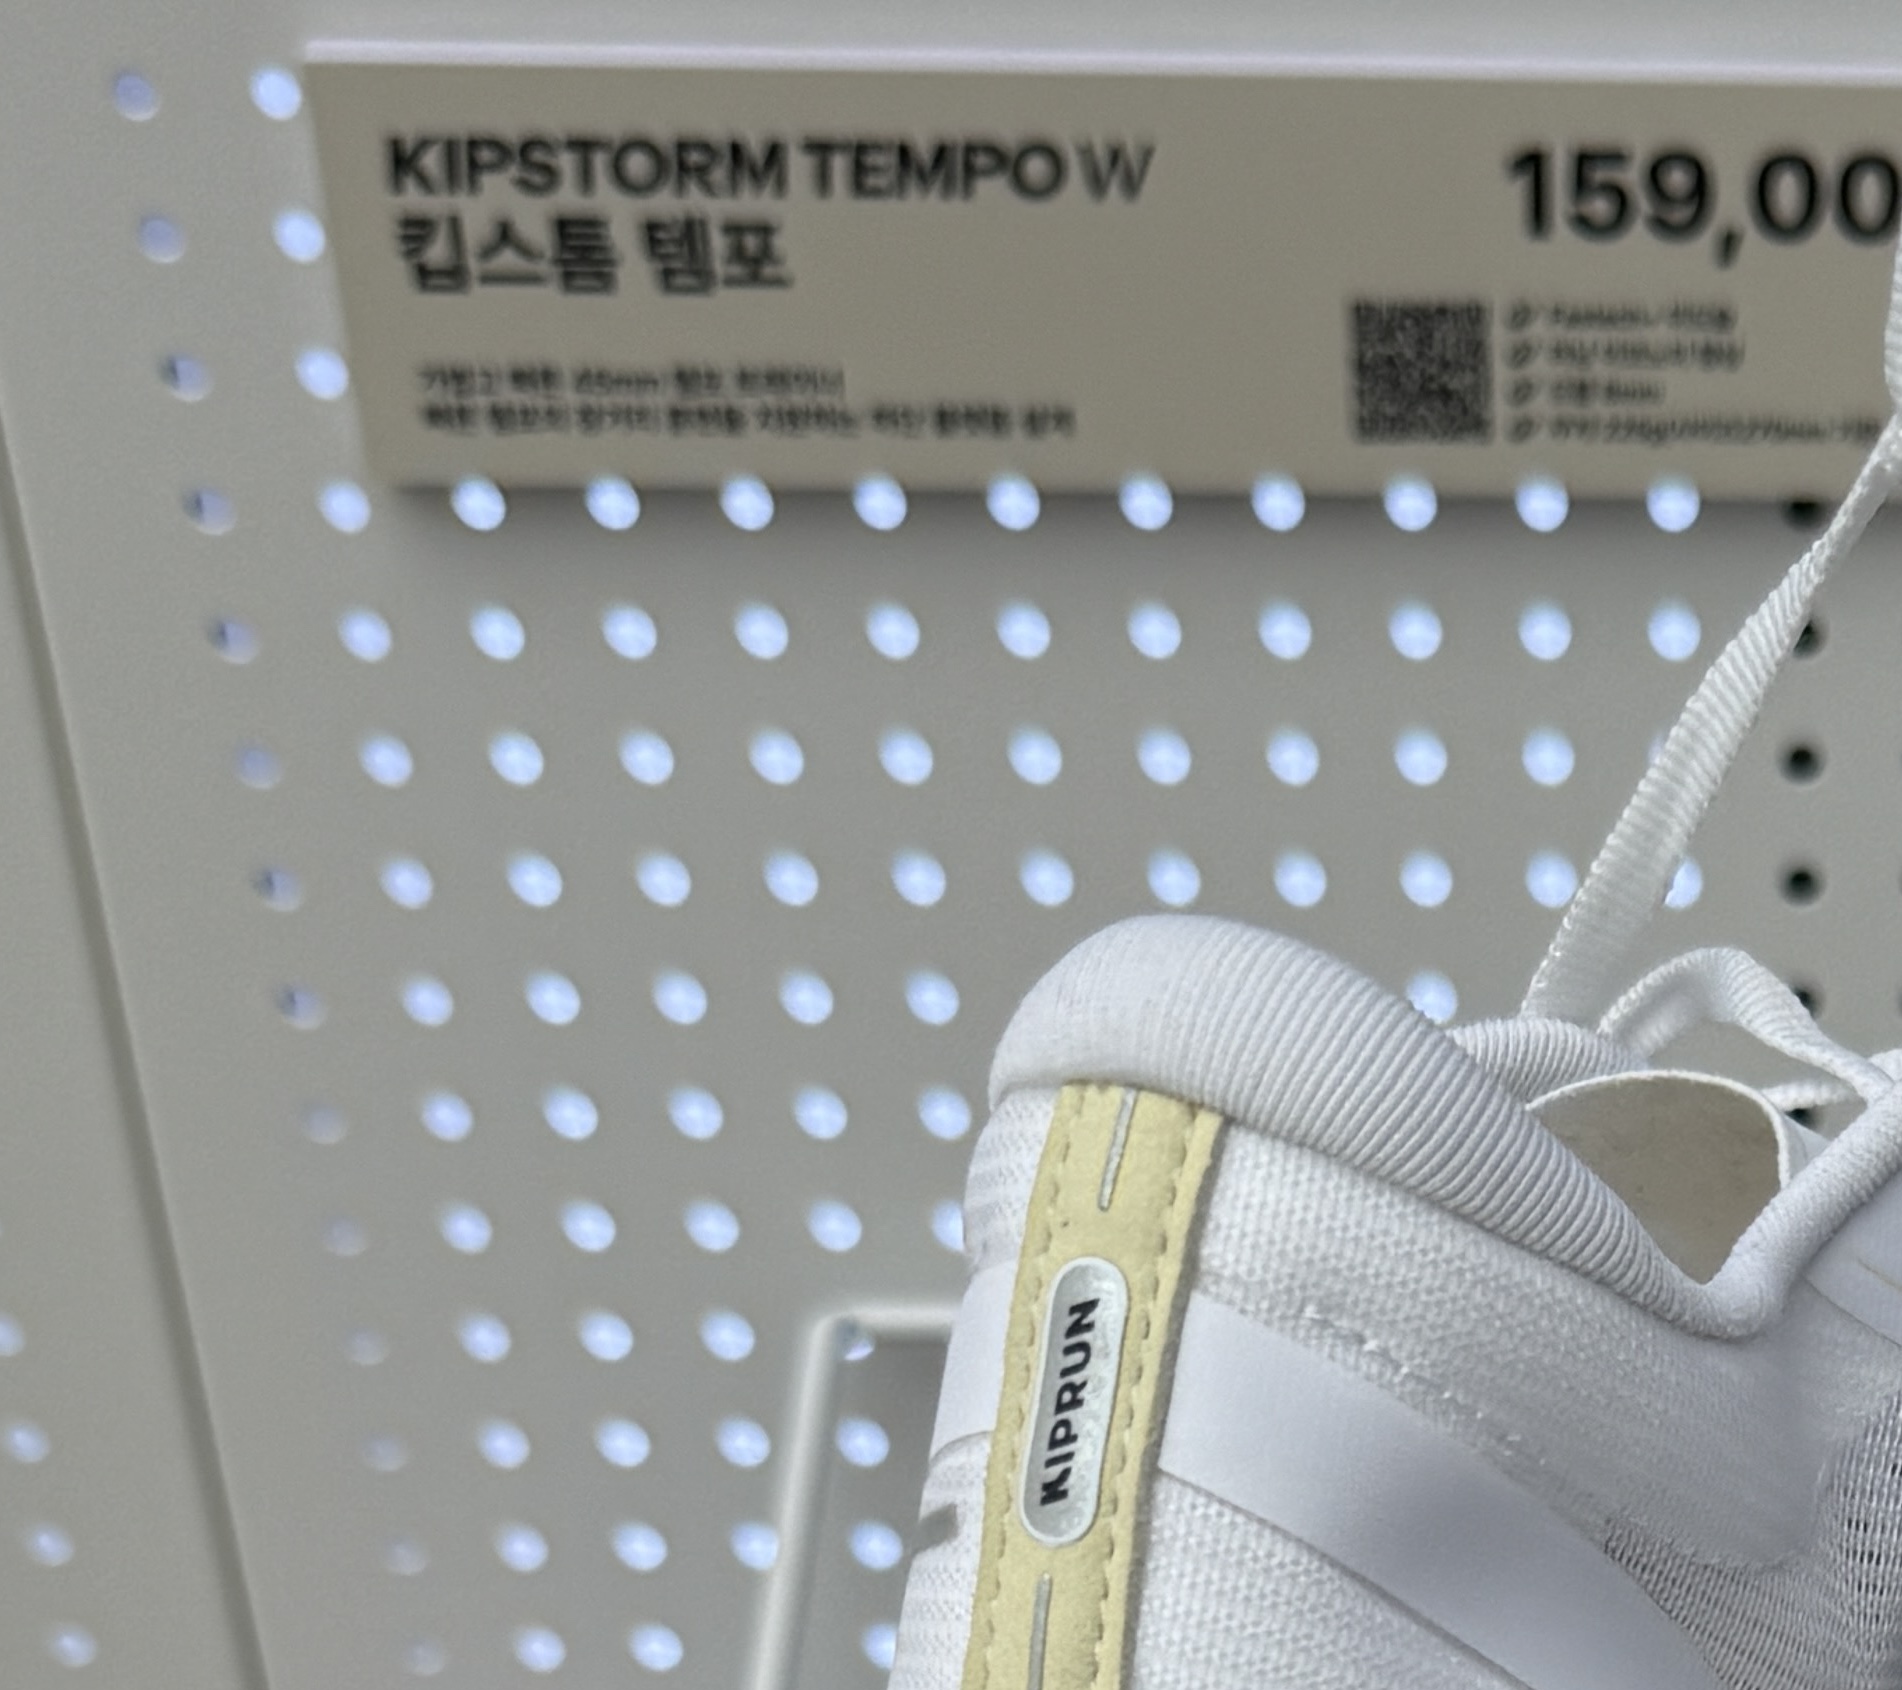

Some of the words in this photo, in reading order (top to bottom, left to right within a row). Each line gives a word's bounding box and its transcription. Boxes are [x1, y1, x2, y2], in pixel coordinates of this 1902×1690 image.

[388, 135, 789, 197] KIPSTORM
[801, 138, 1066, 202] TEMPO
[1074, 142, 1155, 202] W
[398, 215, 622, 295] 킵스톰
[643, 215, 793, 296] 템포
[1039, 1298, 1101, 1507] KIPRUN
